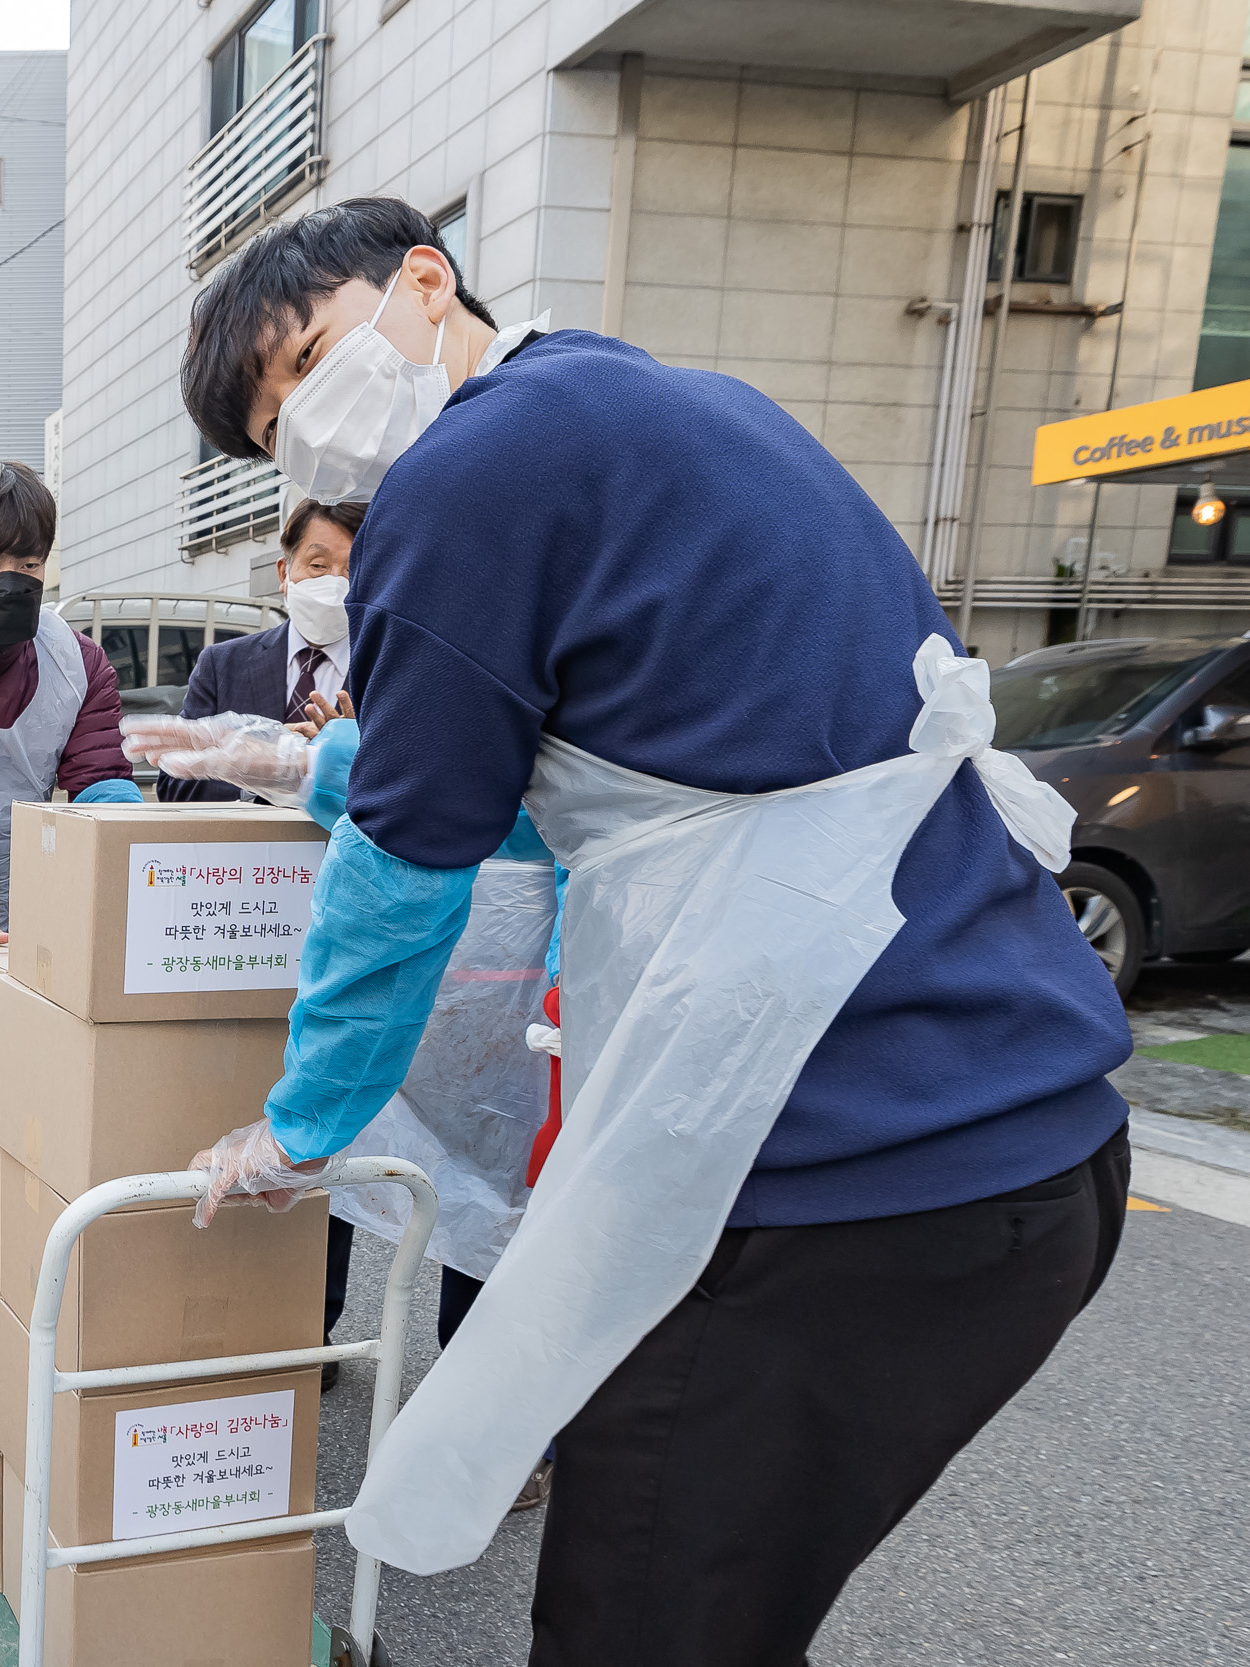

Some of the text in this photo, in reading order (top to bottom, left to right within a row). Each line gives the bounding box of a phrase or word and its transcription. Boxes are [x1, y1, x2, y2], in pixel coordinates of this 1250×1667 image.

[1073, 434, 1155, 466] Coffee
[1160, 426, 1182, 449] &
[252, 866, 316, 884] 김장나눔
[191, 900, 279, 917] 맛있게 드시고
[165, 922, 302, 941] 따뜻한 겨울보내세요~
[161, 953, 288, 973] 광장동새마을부녀회
[227, 1413, 288, 1434] 김장나눔」
[171, 1446, 252, 1469] 맛있게 드시고
[148, 1463, 274, 1490] 따뜻한 겨울보내세요~
[145, 1489, 261, 1519] 광장동새마을부녀회
